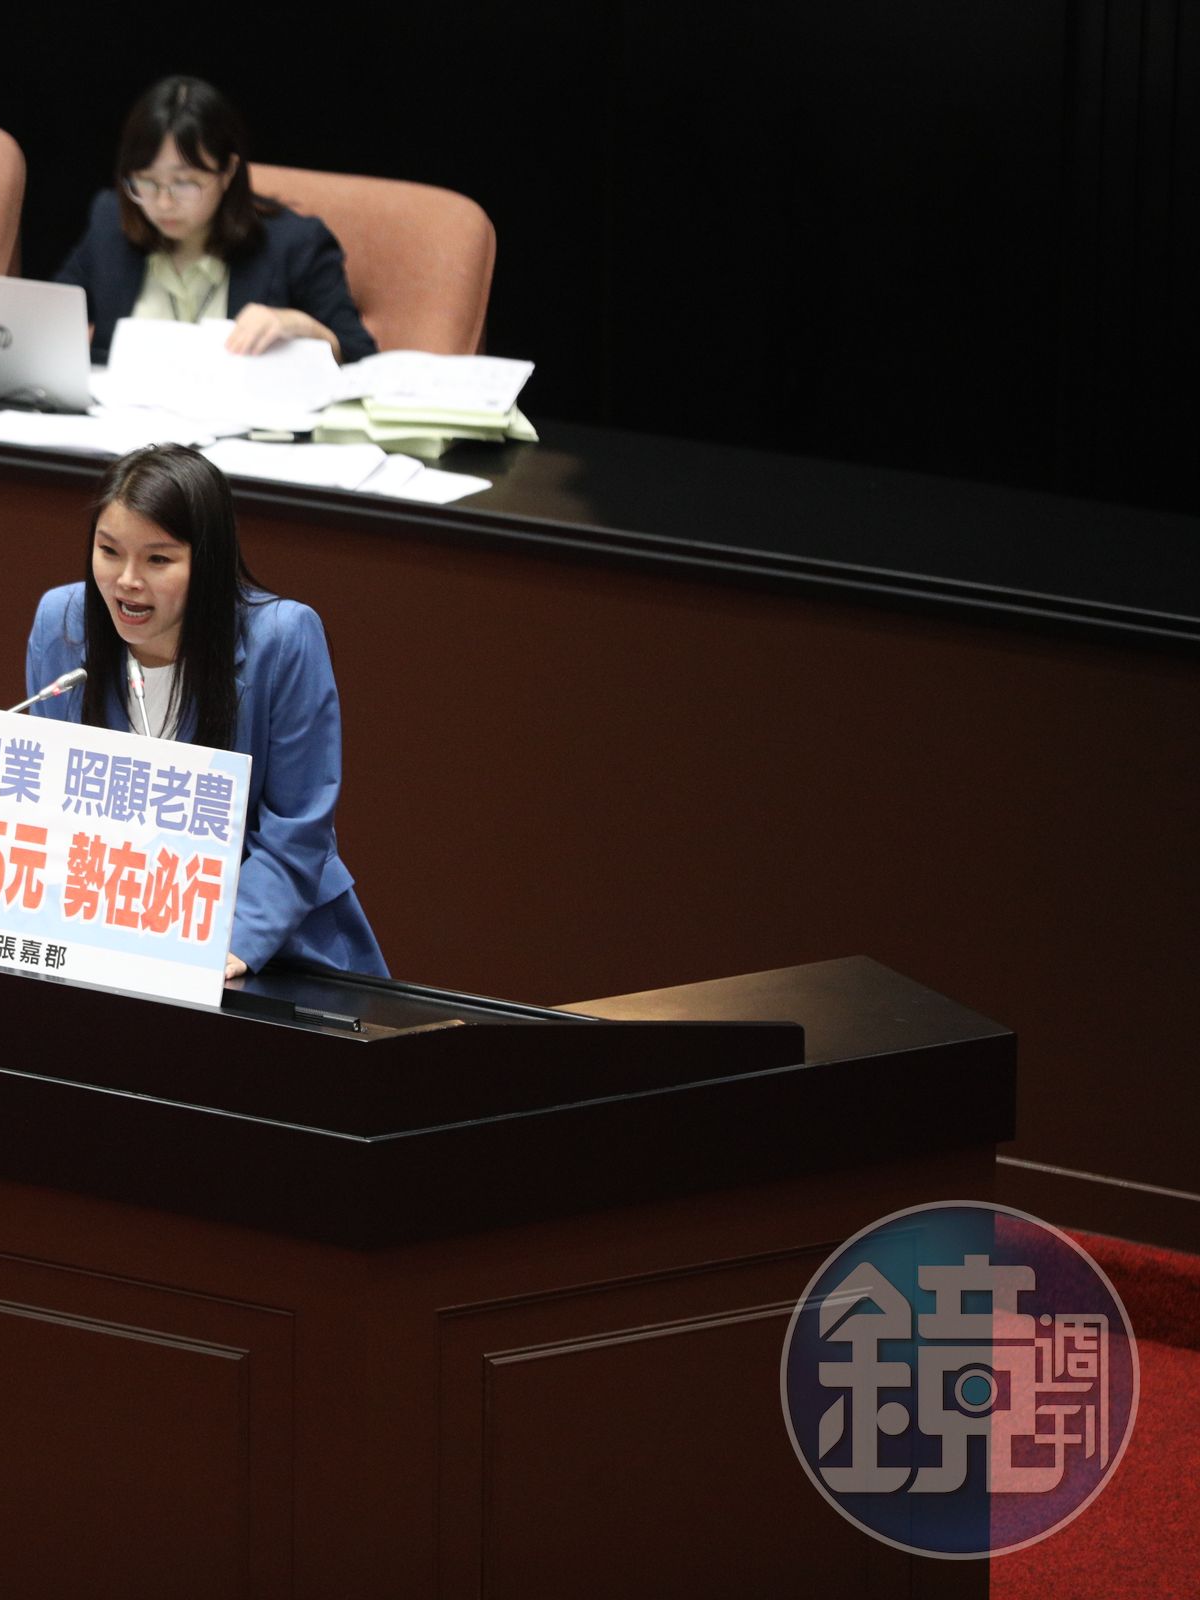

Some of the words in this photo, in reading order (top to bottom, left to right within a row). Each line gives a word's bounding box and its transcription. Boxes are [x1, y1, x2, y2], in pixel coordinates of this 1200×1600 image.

[61, 747, 234, 842] 照顧老農
[63, 831, 223, 942] 勢在必行
